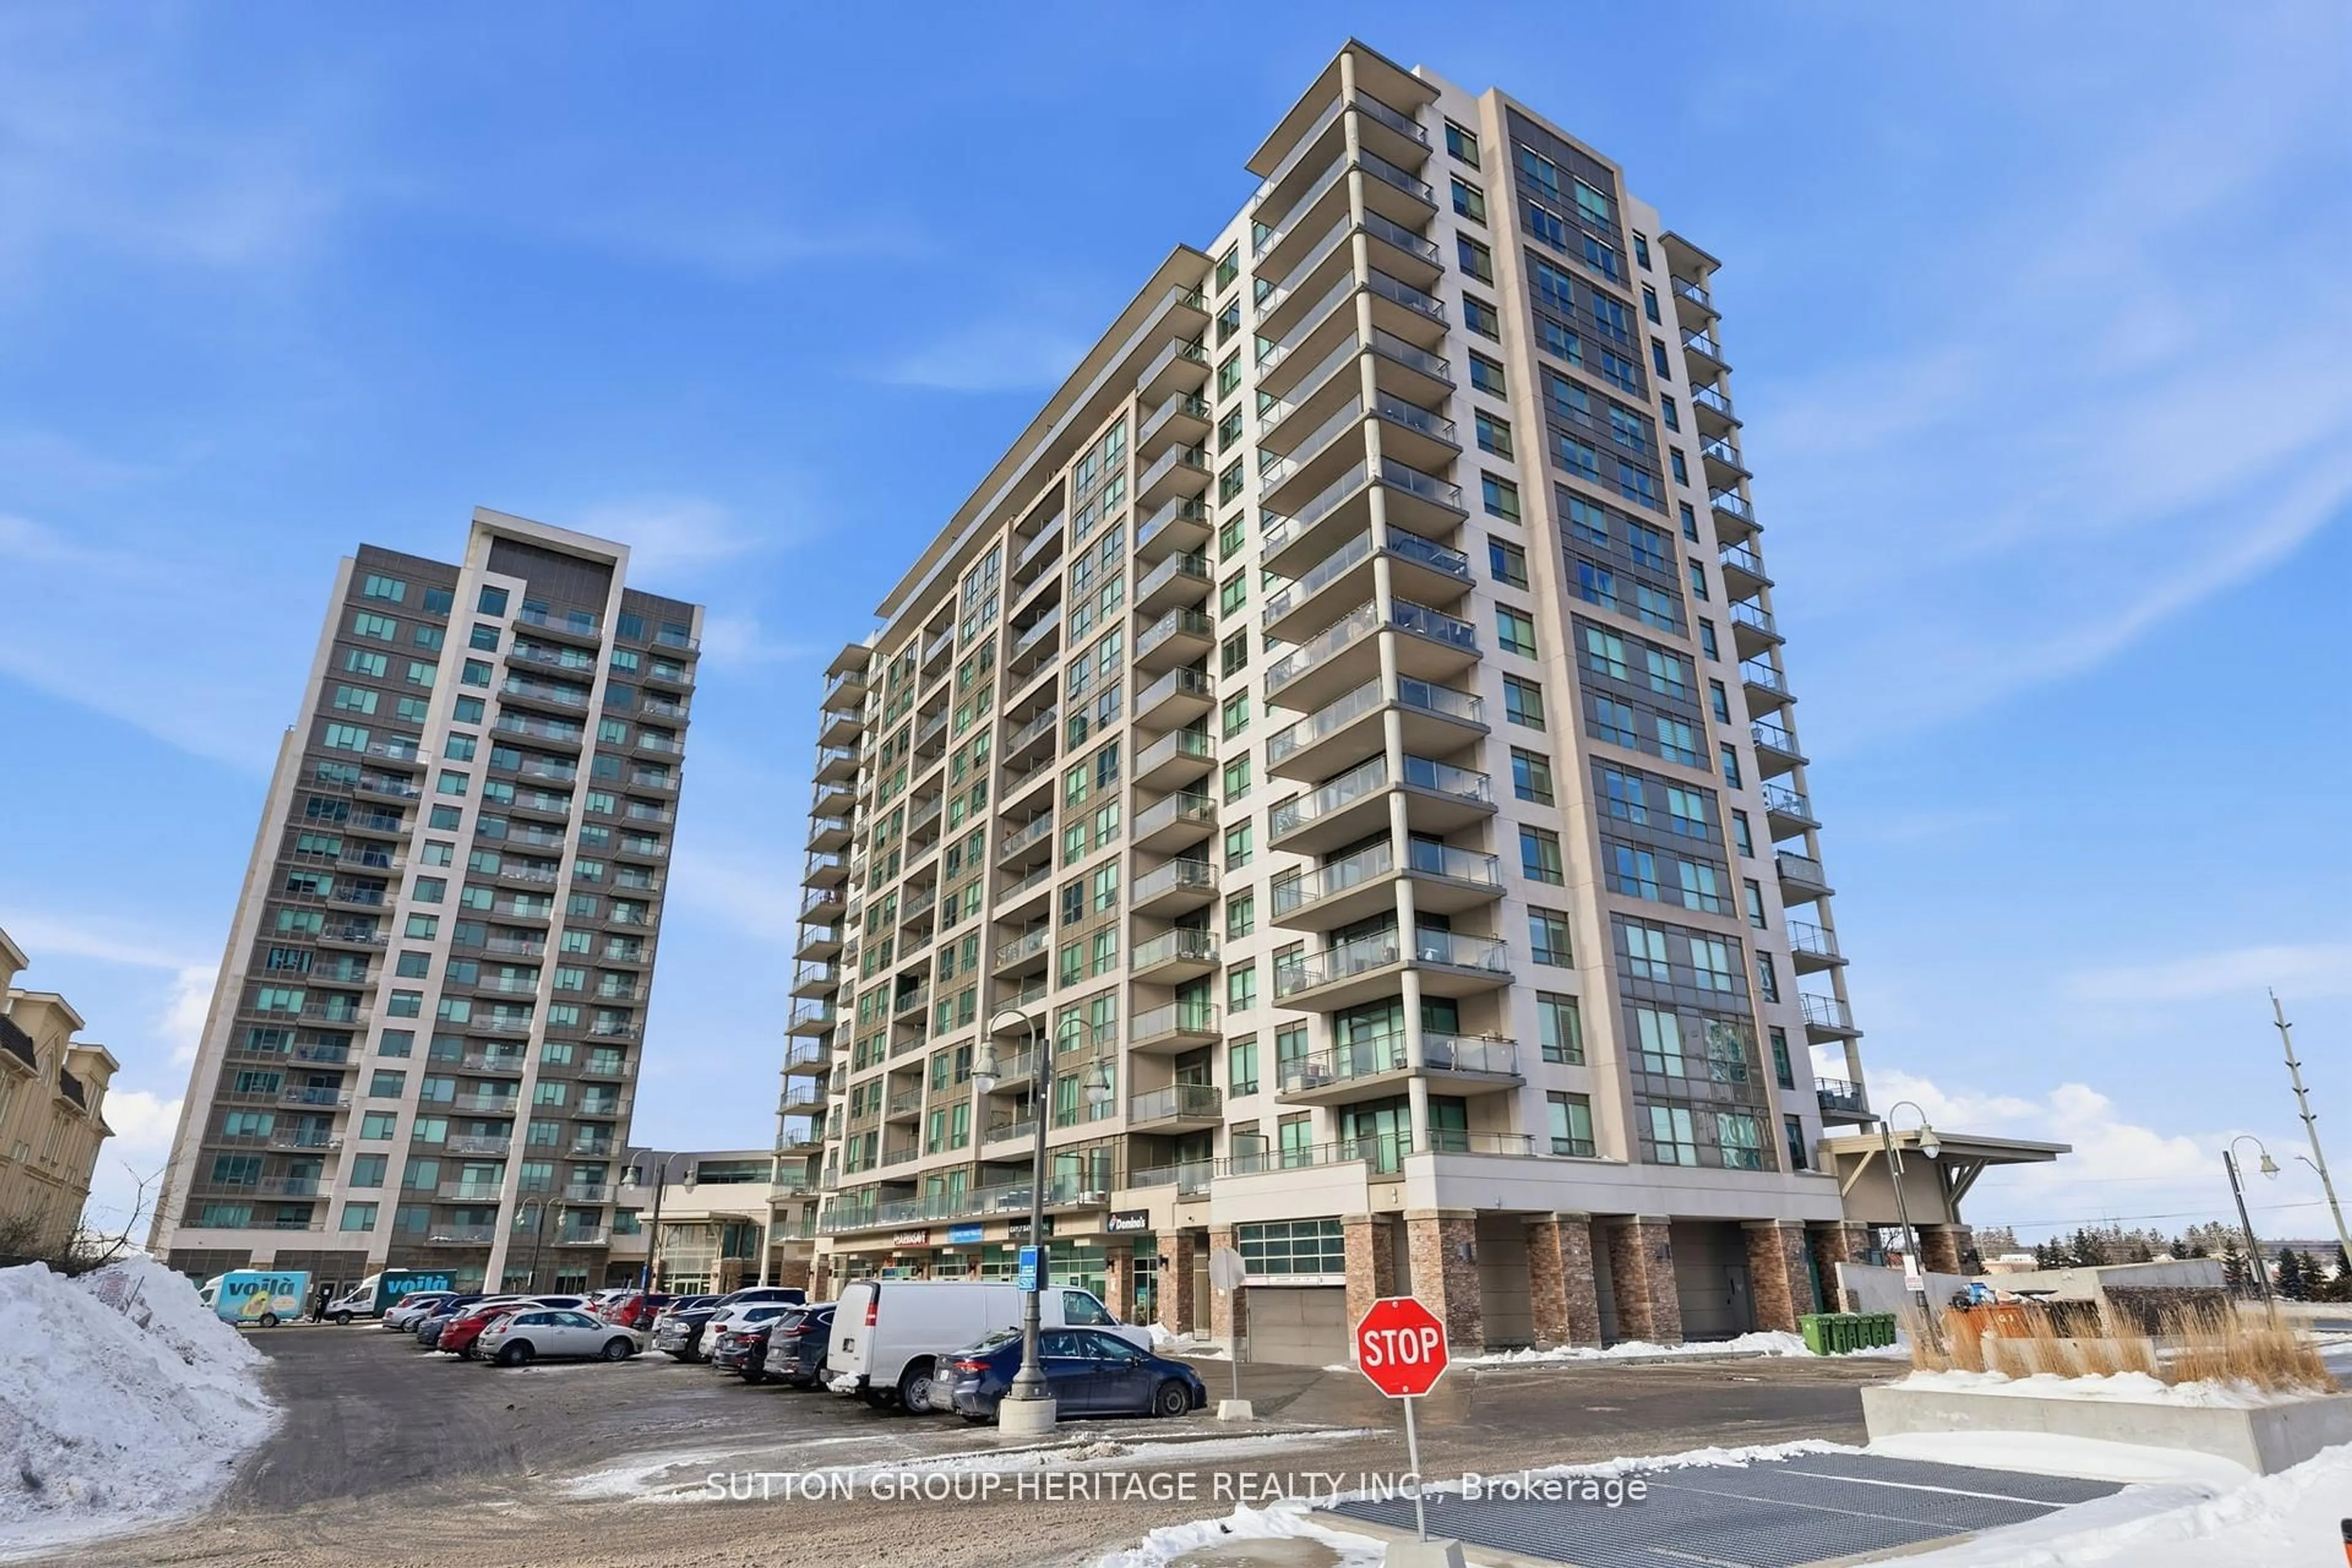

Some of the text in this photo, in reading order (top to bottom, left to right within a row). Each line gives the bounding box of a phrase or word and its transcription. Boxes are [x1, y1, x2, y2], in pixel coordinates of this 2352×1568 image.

[1116, 1216, 1145, 1230] Domino's
[230, 1278, 295, 1295] voilà
[1364, 1327, 1439, 1366] STOP
